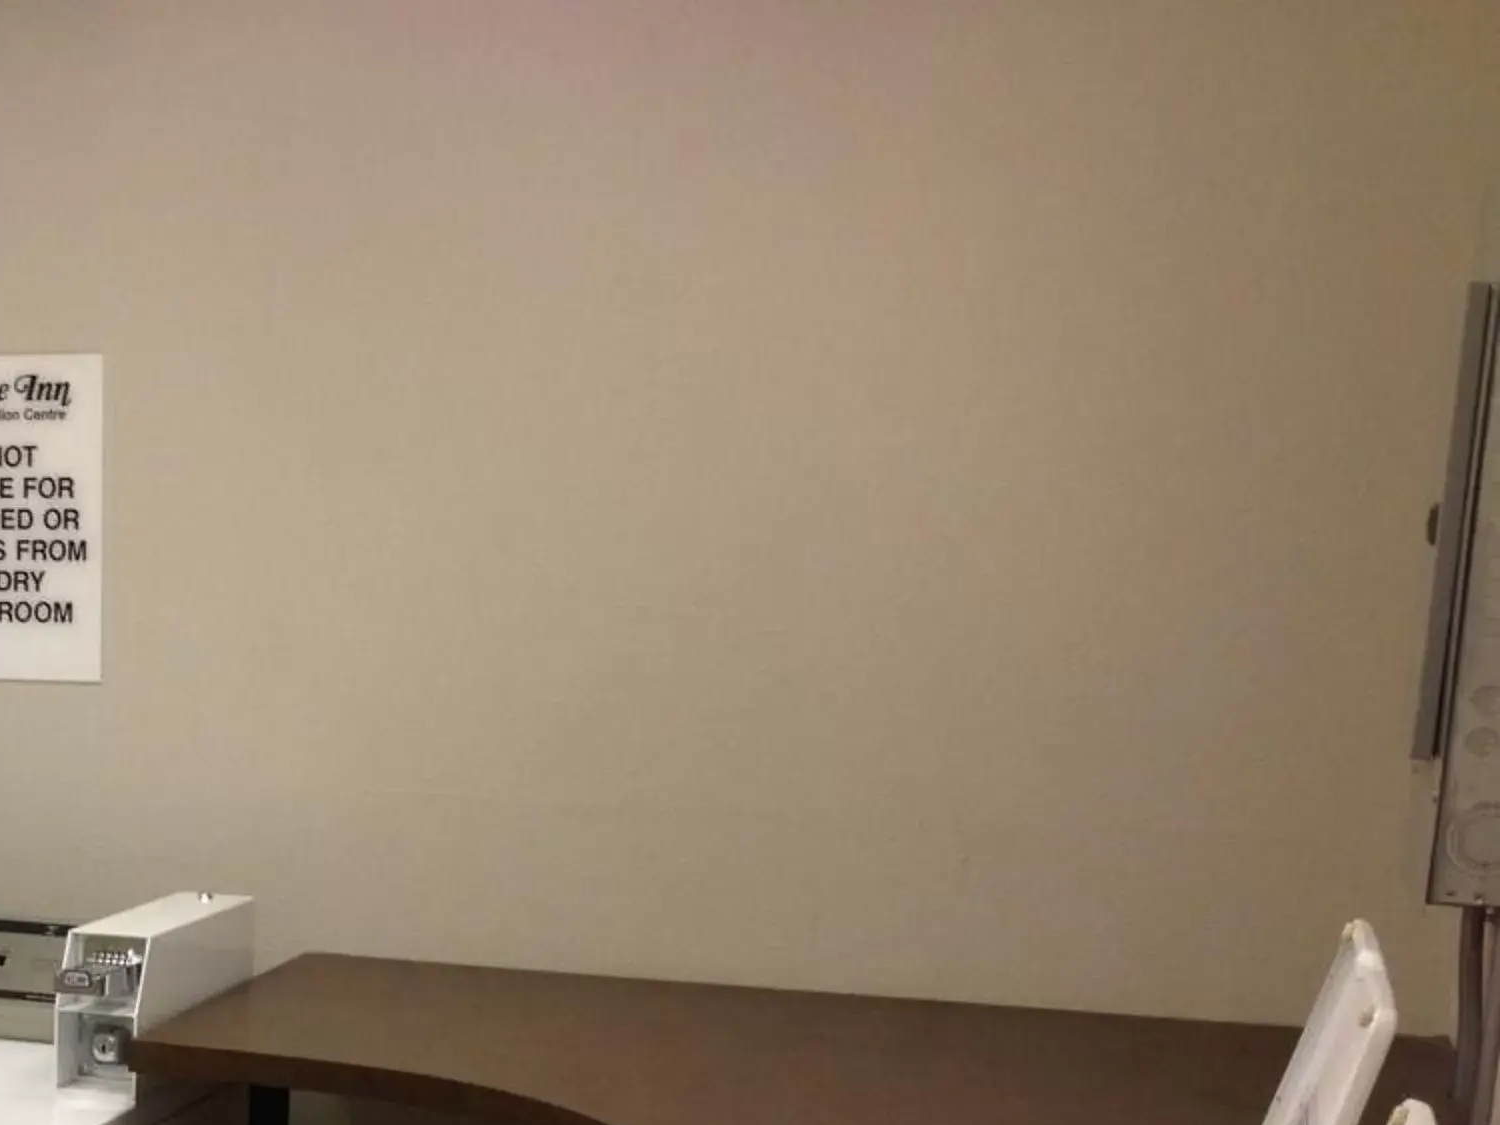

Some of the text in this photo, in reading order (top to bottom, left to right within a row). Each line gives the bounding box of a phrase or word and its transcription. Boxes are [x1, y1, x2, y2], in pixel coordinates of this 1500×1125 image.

[14, 374, 72, 407] Inn
[24, 408, 67, 421] Centre
[23, 477, 75, 499] FOR
[43, 508, 80, 530] OR
[17, 539, 87, 561] FROM
